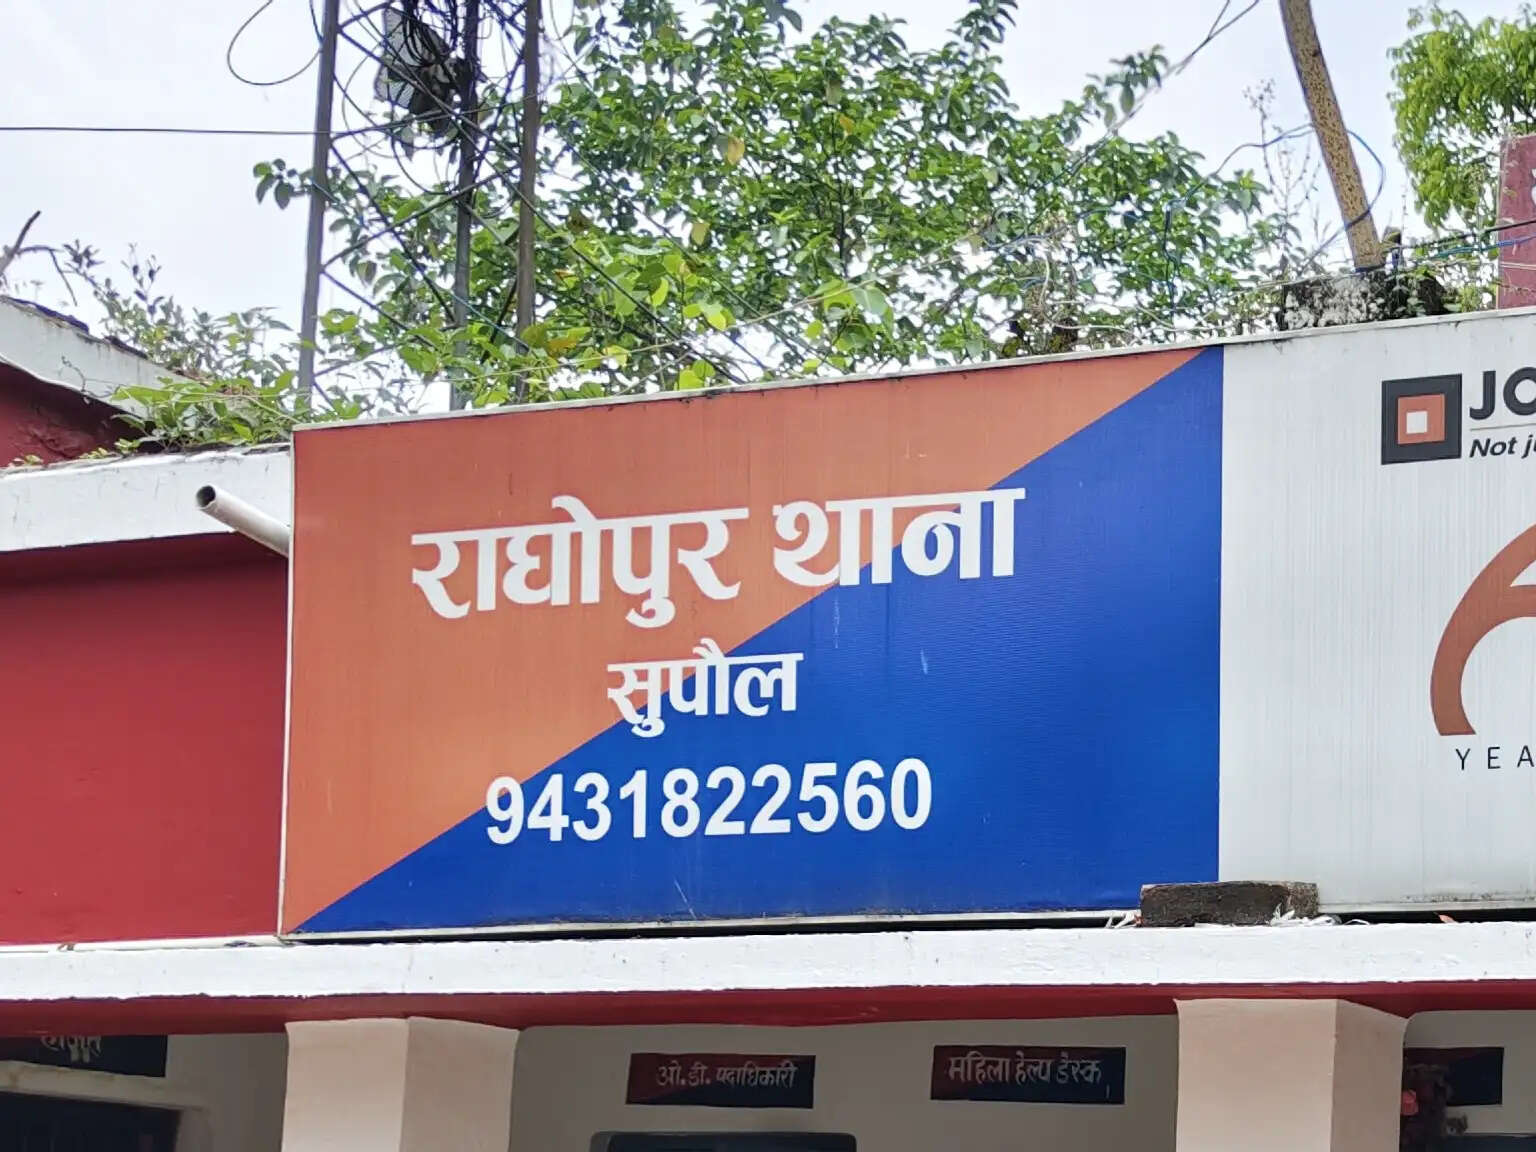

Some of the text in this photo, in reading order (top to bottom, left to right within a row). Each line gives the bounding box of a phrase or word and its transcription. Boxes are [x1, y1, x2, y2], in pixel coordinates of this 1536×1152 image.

[1469, 437, 1516, 458] Not
[411, 487, 1027, 629] राघोपुर थाना
[606, 637, 804, 738] सुपौल
[485, 757, 932, 845] 9431822560
[948, 1050, 1011, 1083] महिला
[1014, 1050, 1054, 1085] हेल्प
